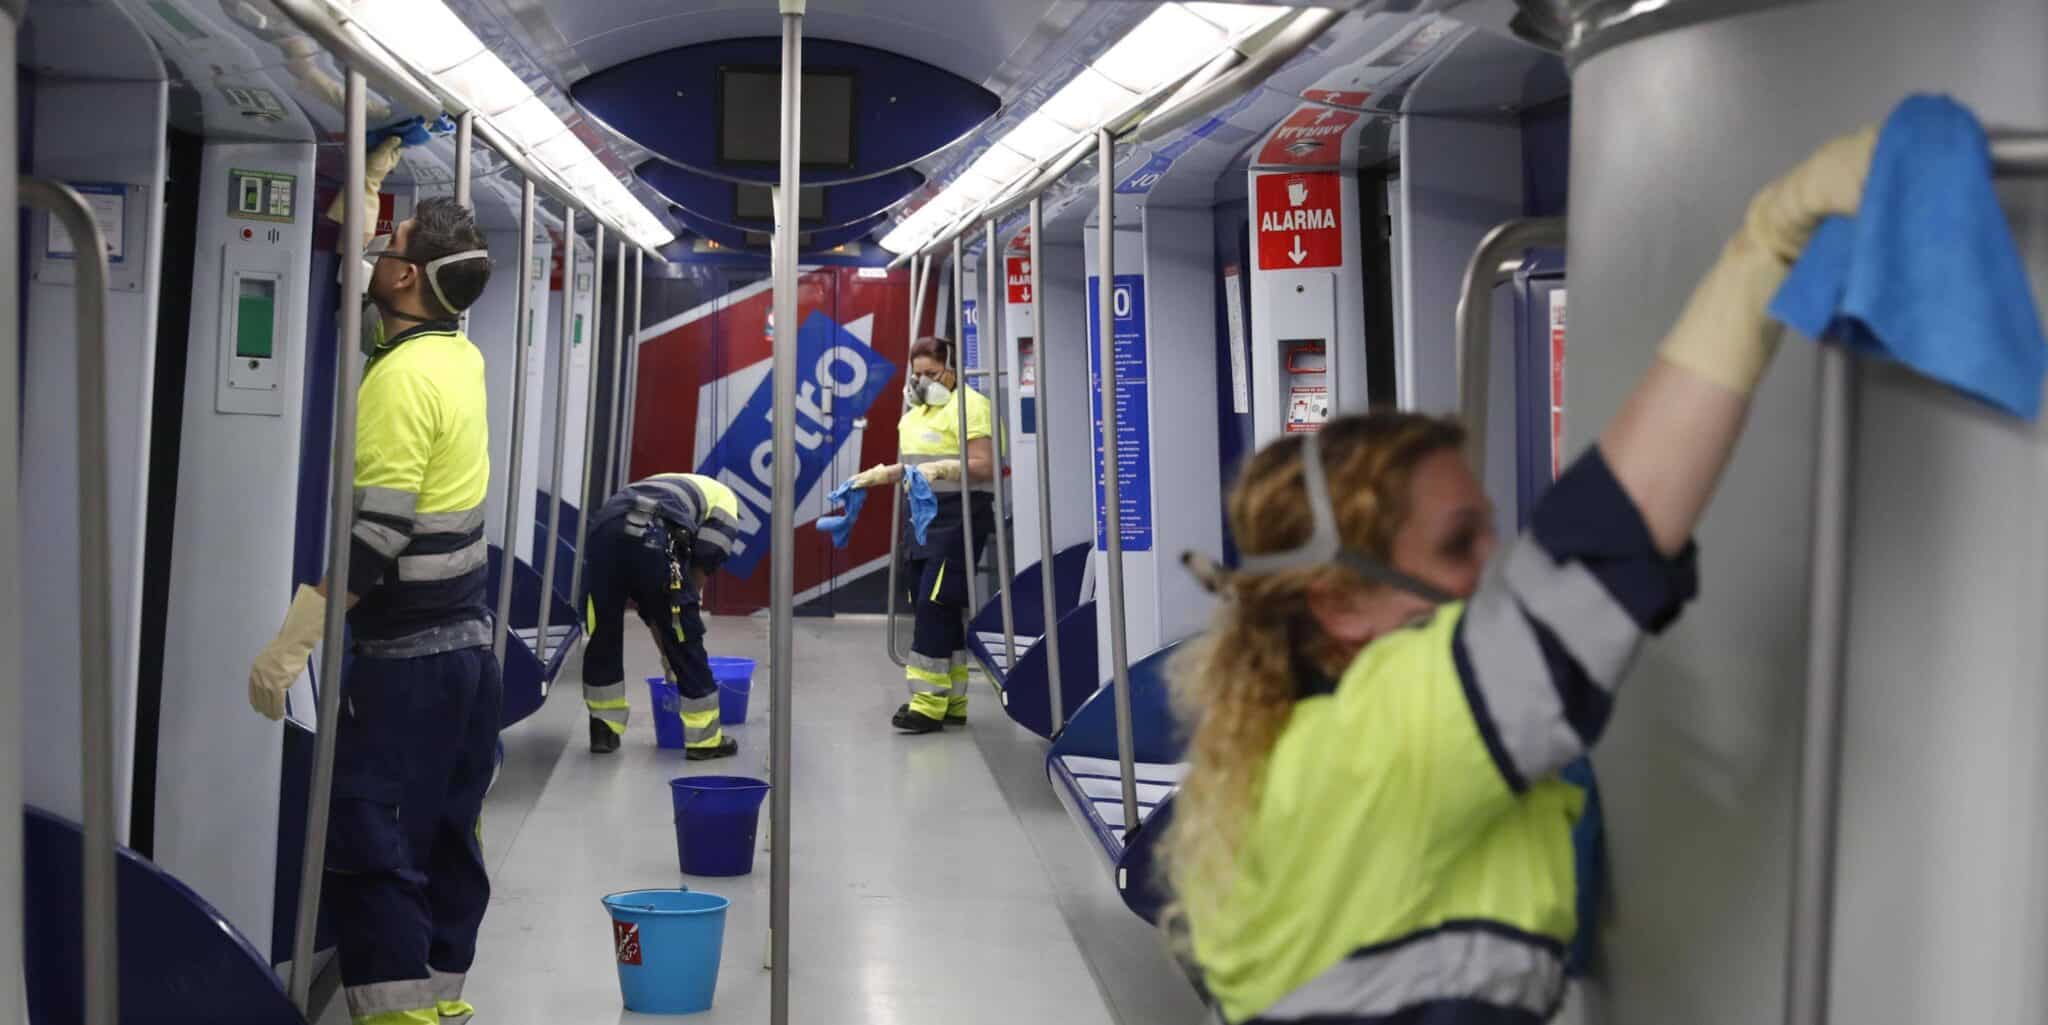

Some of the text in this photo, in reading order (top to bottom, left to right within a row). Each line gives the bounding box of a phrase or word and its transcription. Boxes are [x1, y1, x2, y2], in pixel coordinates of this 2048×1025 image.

[1262, 208, 1336, 232] ALARMA
[1009, 274, 1032, 286] ALAR
[1114, 288, 1130, 317] 0
